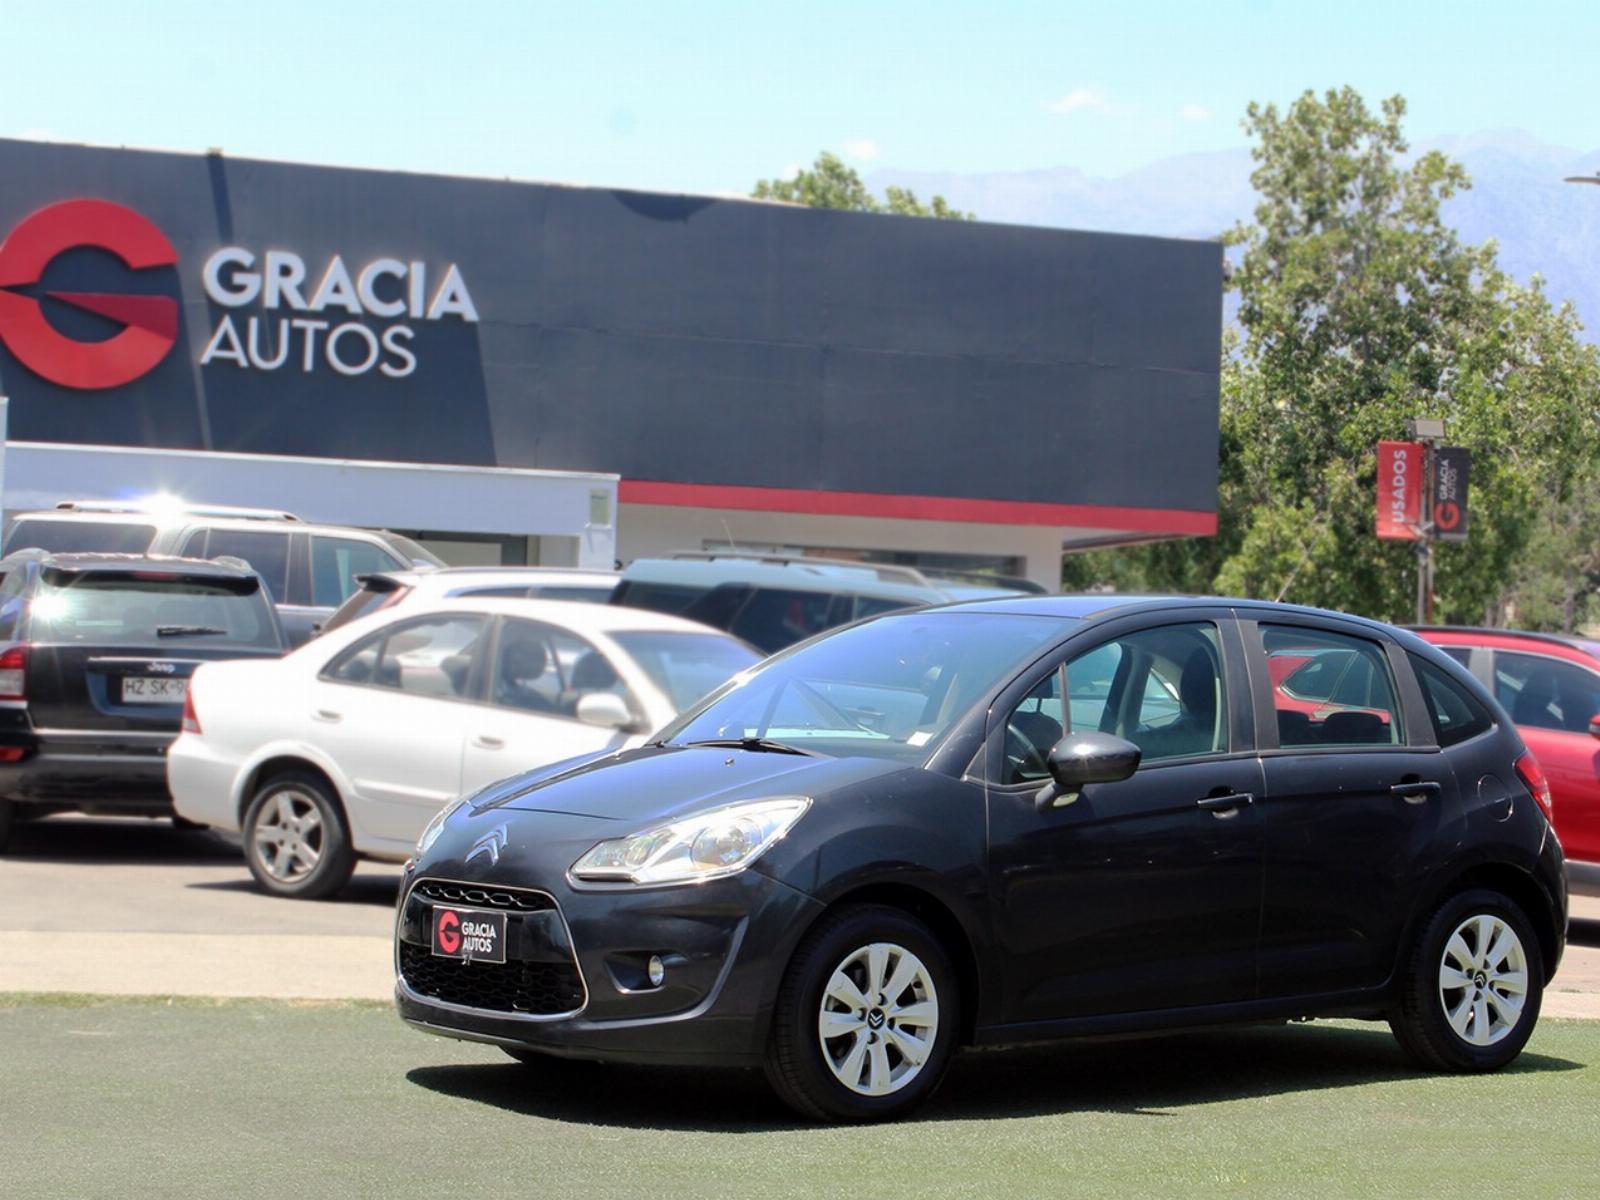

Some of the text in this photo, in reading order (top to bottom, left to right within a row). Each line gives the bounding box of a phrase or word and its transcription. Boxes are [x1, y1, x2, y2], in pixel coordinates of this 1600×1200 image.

[203, 247, 480, 323] GRACIA
[200, 315, 418, 379] AUTOS
[1392, 450, 1406, 523] USADOS
[1439, 459, 1450, 500] GRACIA
[1448, 468, 1458, 500] AUTOS
[461, 921, 497, 938] GRACIA
[462, 937, 493, 953] AUTOS
